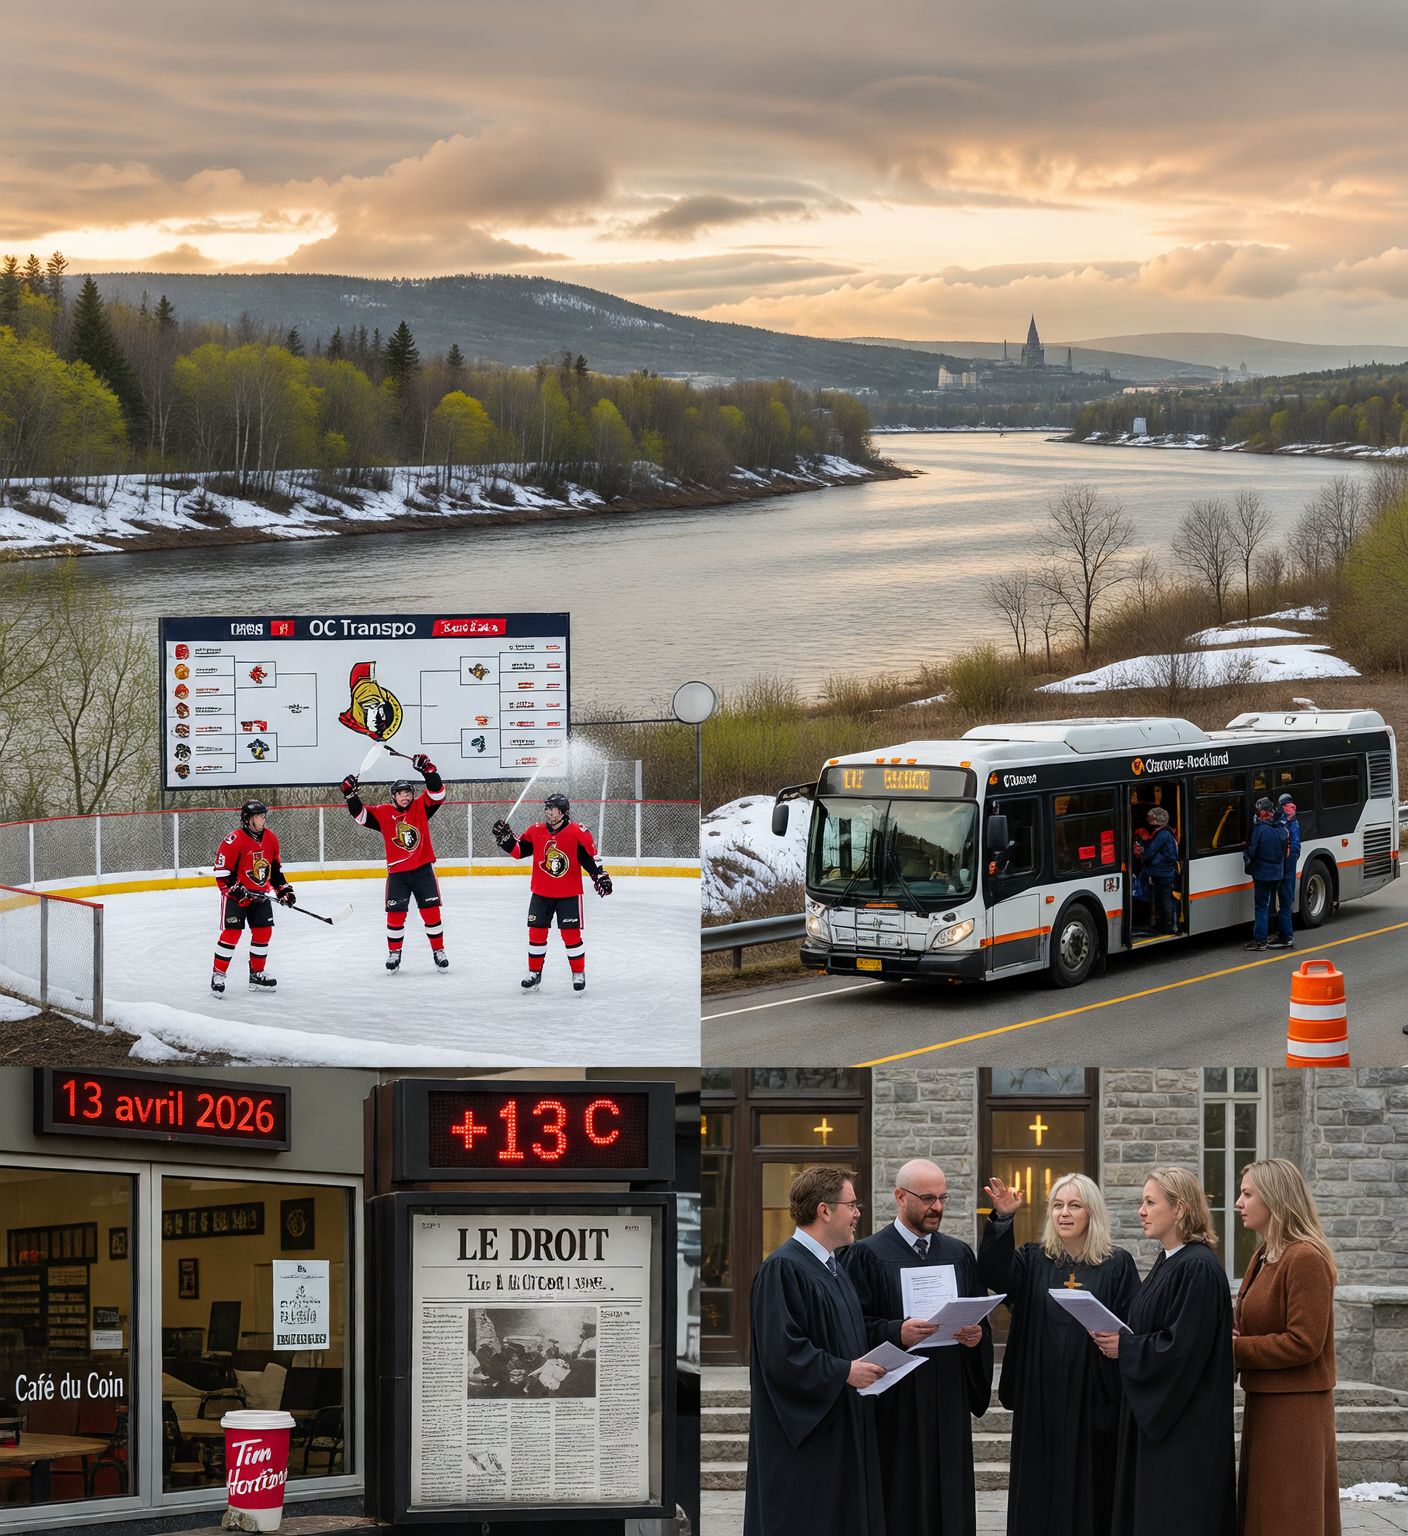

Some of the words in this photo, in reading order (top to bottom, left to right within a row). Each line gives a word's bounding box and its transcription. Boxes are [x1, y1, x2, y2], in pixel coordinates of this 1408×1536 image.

[309, 620, 336, 636] OC
[341, 619, 416, 638] Transpo
[63, 1080, 103, 1119] 13
[115, 1091, 184, 1126] avril
[196, 1093, 275, 1133] 2026
[451, 1100, 567, 1160] +13
[584, 1099, 620, 1145] C
[457, 1228, 498, 1261] LE
[509, 1228, 609, 1262] DROIT
[15, 1373, 54, 1402] Café
[60, 1373, 81, 1400] du
[87, 1372, 124, 1399] Coin
[231, 1438, 271, 1467] Tim
